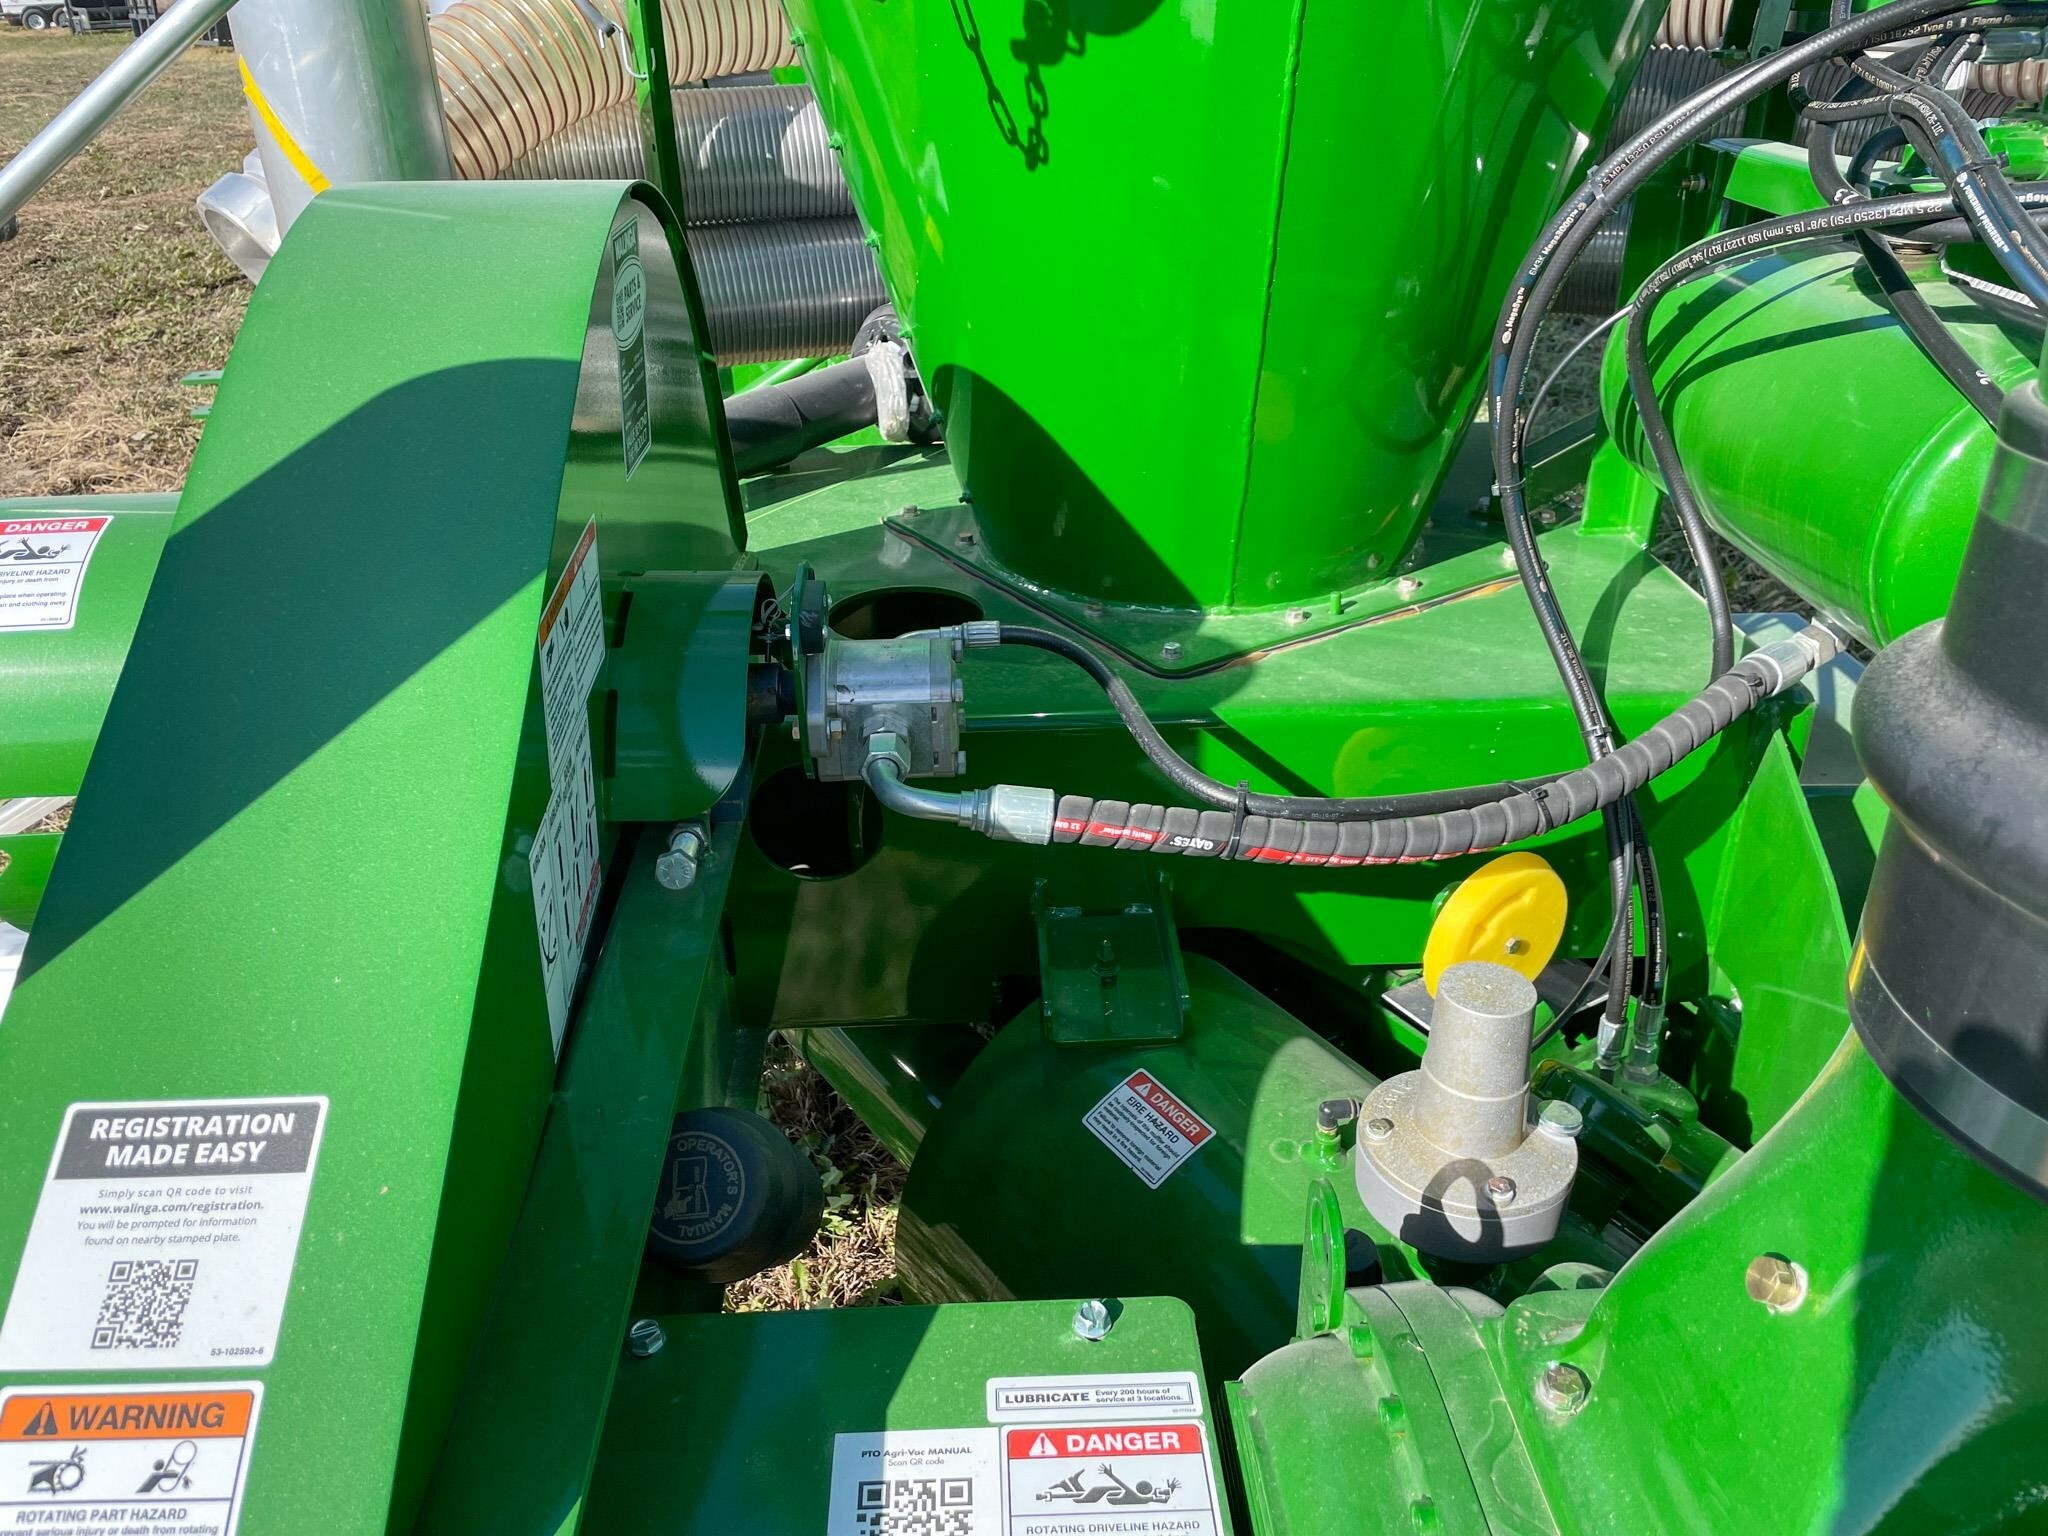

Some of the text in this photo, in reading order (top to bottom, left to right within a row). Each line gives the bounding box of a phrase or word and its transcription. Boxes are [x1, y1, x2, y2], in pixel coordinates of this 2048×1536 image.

[1923, 23, 1944, 35] Type
[1972, 15, 2002, 26] Flame
[2015, 192, 2048, 204] Mega
[1830, 213, 1852, 228] PSI)
[1852, 207, 1887, 223] (3250
[1762, 225, 1785, 241] mm)
[1786, 220, 1805, 234] (9.5
[1723, 236, 1748, 250] 11237
[1748, 232, 1763, 245] ISO
[4, 520, 90, 533] DANGER
[36, 568, 70, 576] HAZARD
[1150, 1092, 1200, 1137] DANGER
[90, 1113, 296, 1140] REGISTRATION
[105, 1140, 268, 1167] MADE EASY
[98, 1186, 253, 1200] Simply scan QR code to visit
[80, 1200, 264, 1216] www.walinga.com/registration.
[78, 1216, 257, 1232] You will be prompted for information
[84, 1232, 240, 1246] found on nearby stamped plate.
[1005, 1392, 1090, 1404] LUBRICATE
[1095, 1388, 1118, 1398] Every
[1120, 1388, 1135, 1396] 200
[1144, 1394, 1184, 1402] locations.
[69, 1402, 226, 1431] WARNING
[1066, 1432, 1181, 1452] DANGER
[862, 1446, 973, 1459] PTO Agri-Vac MANUAL
[888, 1457, 945, 1467] Scan QR code
[16, 1508, 188, 1524] ROTATING PART HAZARD
[108, 1528, 120, 1536] or
[121, 1526, 150, 1536] death
[152, 1525, 175, 1534] from
[178, 1524, 219, 1536] rotating
[1026, 1520, 1200, 1535] ROTATING DRIVELINE HAZARD
